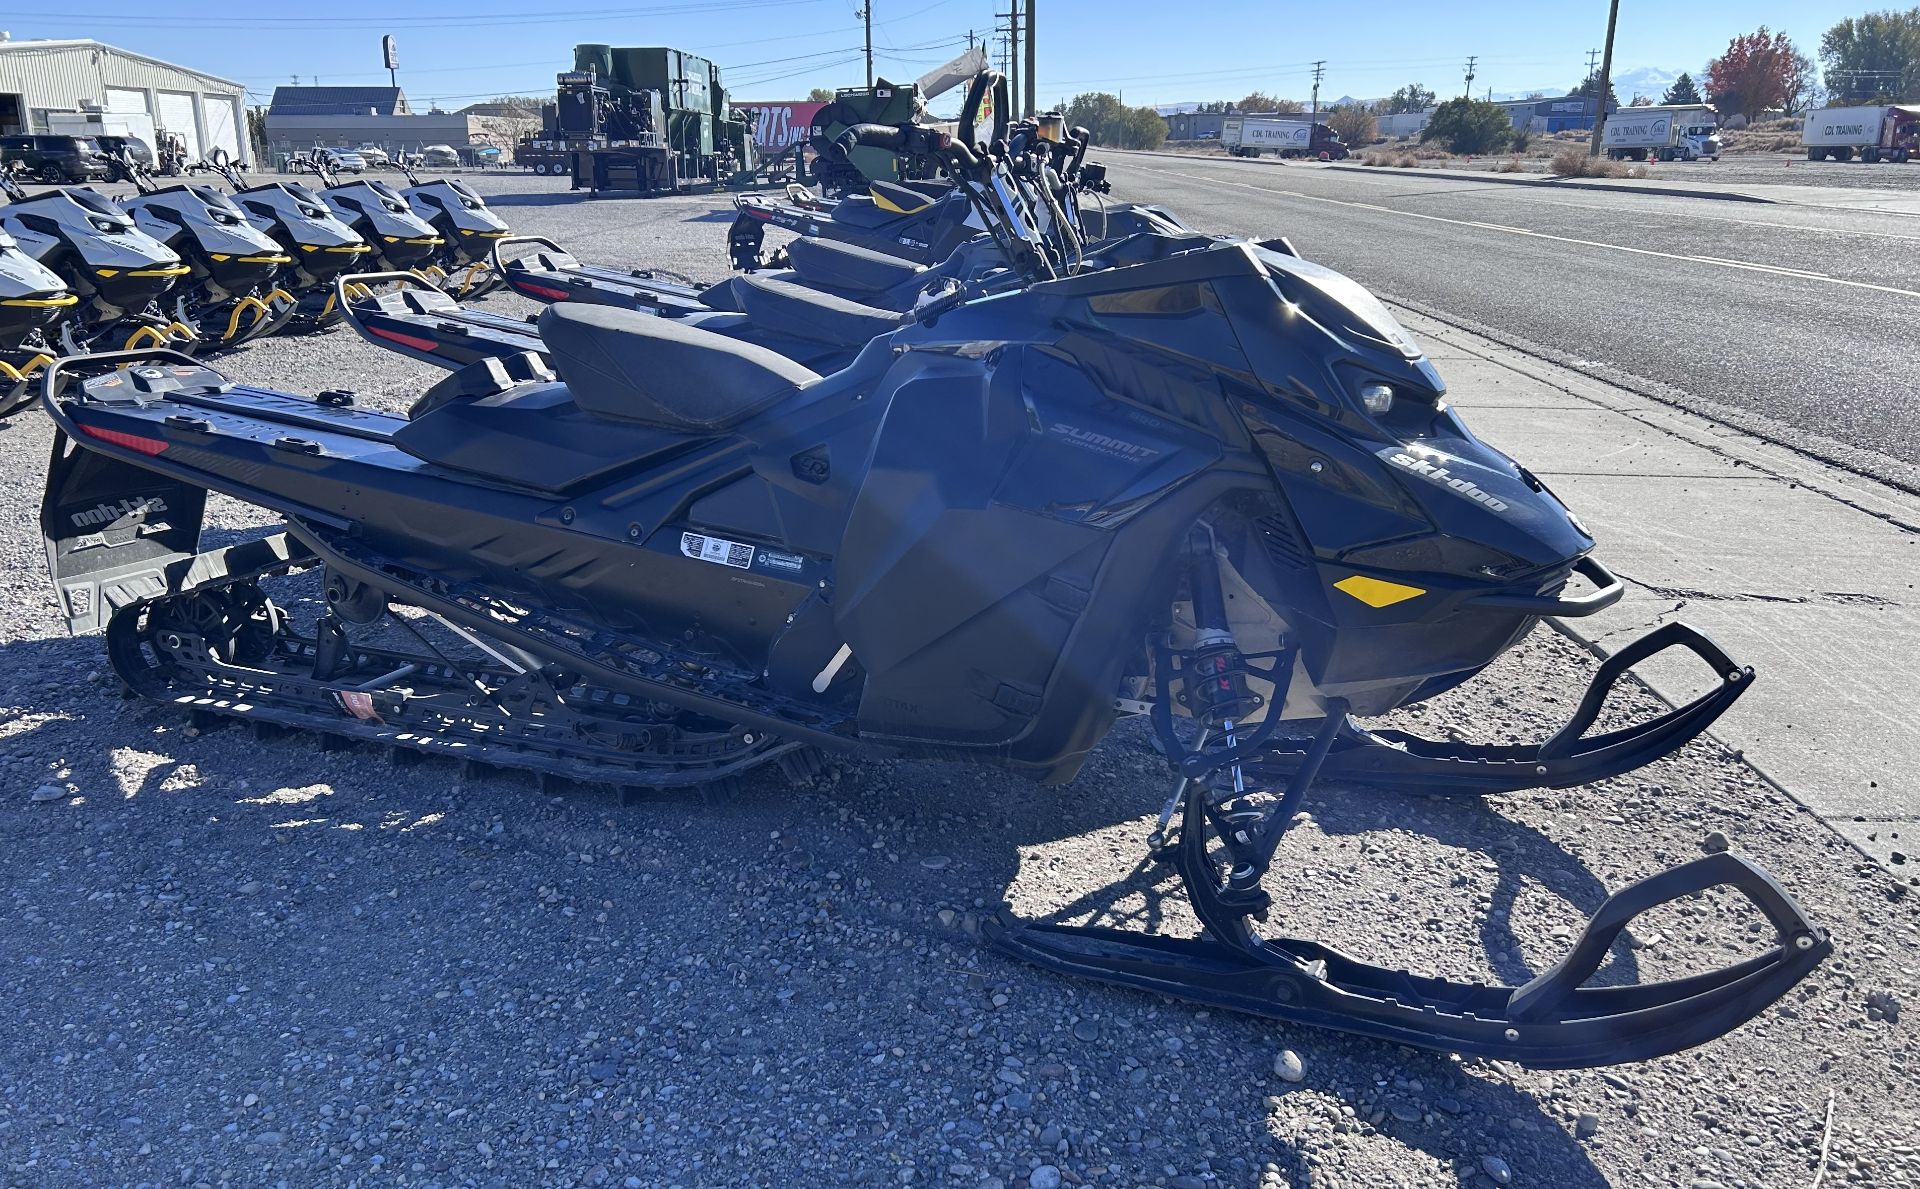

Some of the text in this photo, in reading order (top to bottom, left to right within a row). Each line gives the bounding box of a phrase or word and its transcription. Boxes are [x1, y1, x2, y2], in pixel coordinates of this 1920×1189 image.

[1252, 129, 1290, 139] CDL TRAINING
[1611, 125, 1648, 137] CDL TRAINING
[1825, 124, 1862, 136] CDL TRAINING
[1050, 423, 1159, 457] SUMMIT
[1390, 453, 1508, 512] ski-doo
